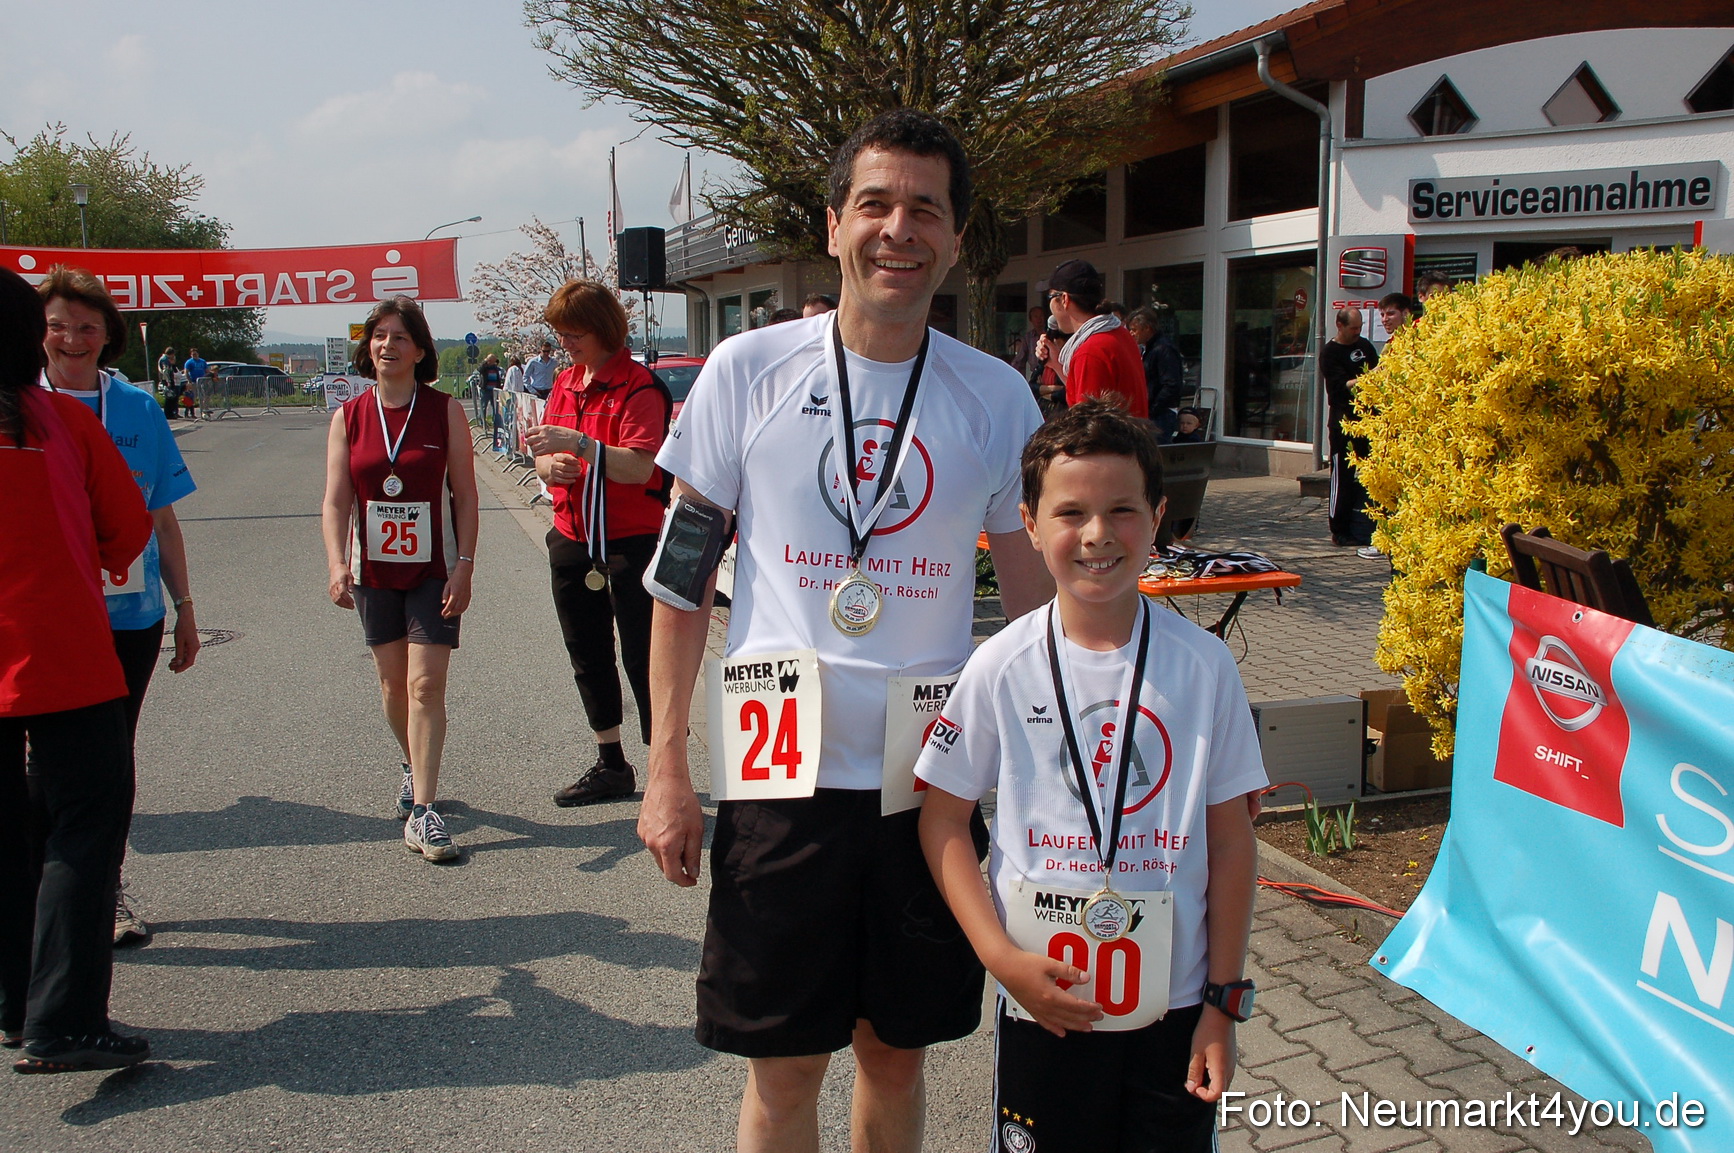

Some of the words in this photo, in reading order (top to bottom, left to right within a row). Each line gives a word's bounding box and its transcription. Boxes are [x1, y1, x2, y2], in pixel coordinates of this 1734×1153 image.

[1412, 170, 1711, 219] Serviceannahme
[1332, 300, 1379, 309] SEA
[110, 432, 139, 448] auf
[376, 505, 406, 514] MEYER
[381, 520, 418, 556] 25
[867, 557, 903, 573] MIT
[911, 556, 952, 577] HERZ
[799, 576, 819, 589] Dr.
[897, 584, 939, 599] Röschl
[723, 661, 774, 682] MEYER
[1531, 664, 1600, 699] NISSAN
[723, 679, 776, 694] WERBUNG
[913, 681, 958, 701] MEY
[1026, 715, 1053, 724] erima
[740, 697, 802, 781] 24
[1046, 858, 1065, 871] Dr.
[1119, 861, 1139, 873] Dr.
[1034, 908, 1082, 926] WERBU
